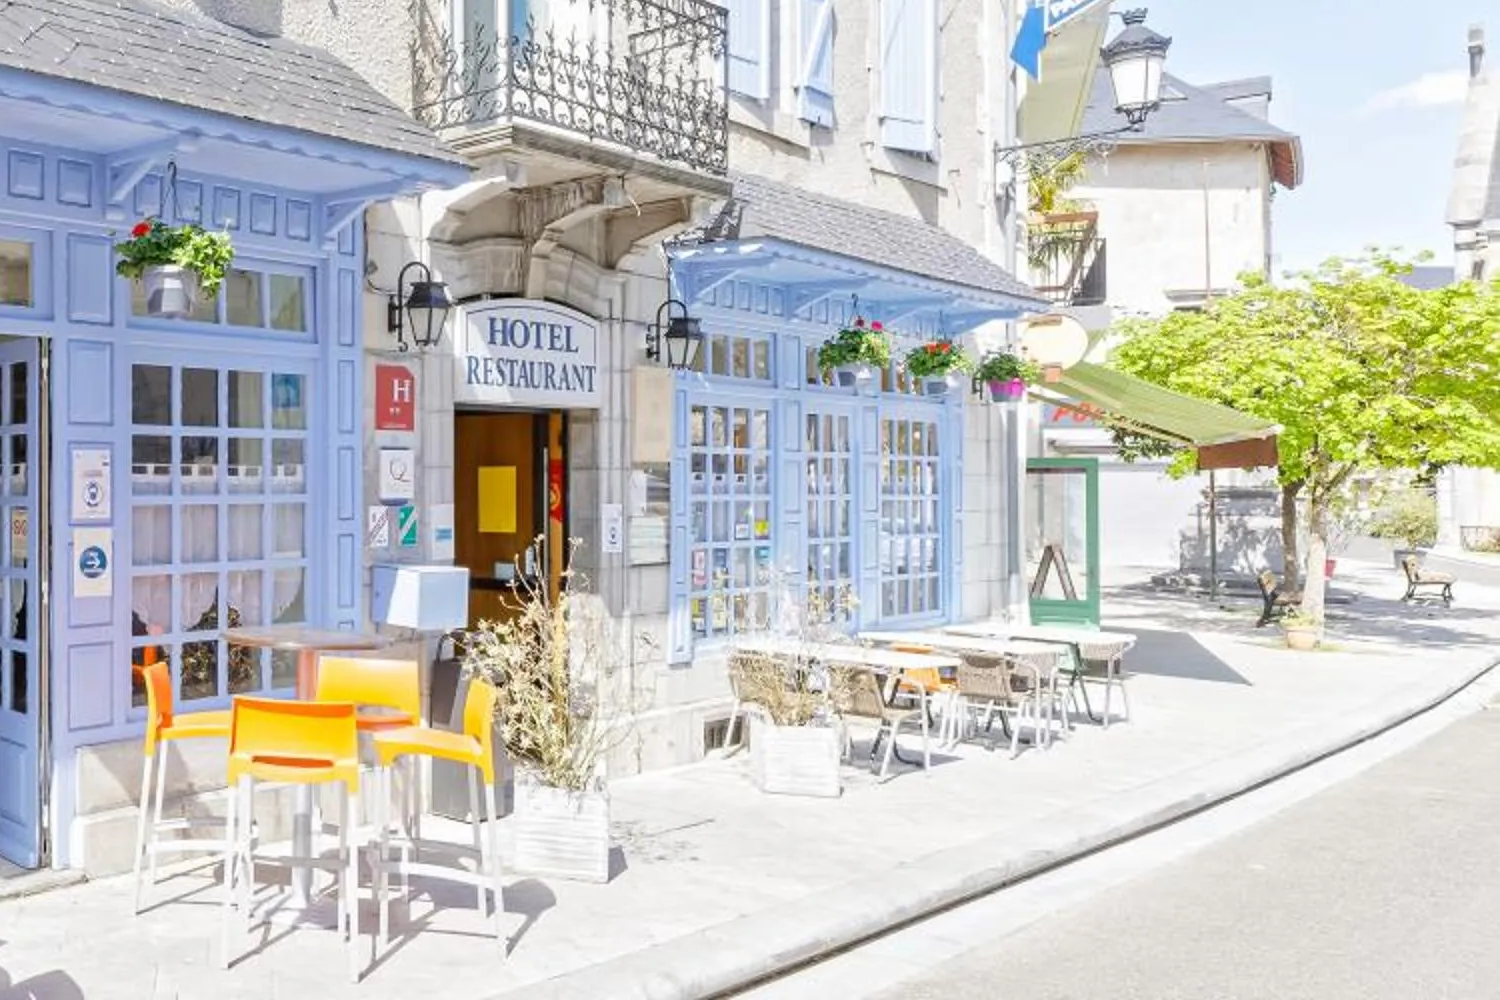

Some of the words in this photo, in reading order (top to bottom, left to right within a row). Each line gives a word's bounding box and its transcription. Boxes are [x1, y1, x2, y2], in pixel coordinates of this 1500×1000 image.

[488, 317, 579, 353] HOTEL
[392, 379, 411, 403] H
[467, 356, 596, 392] RESTAURANT
